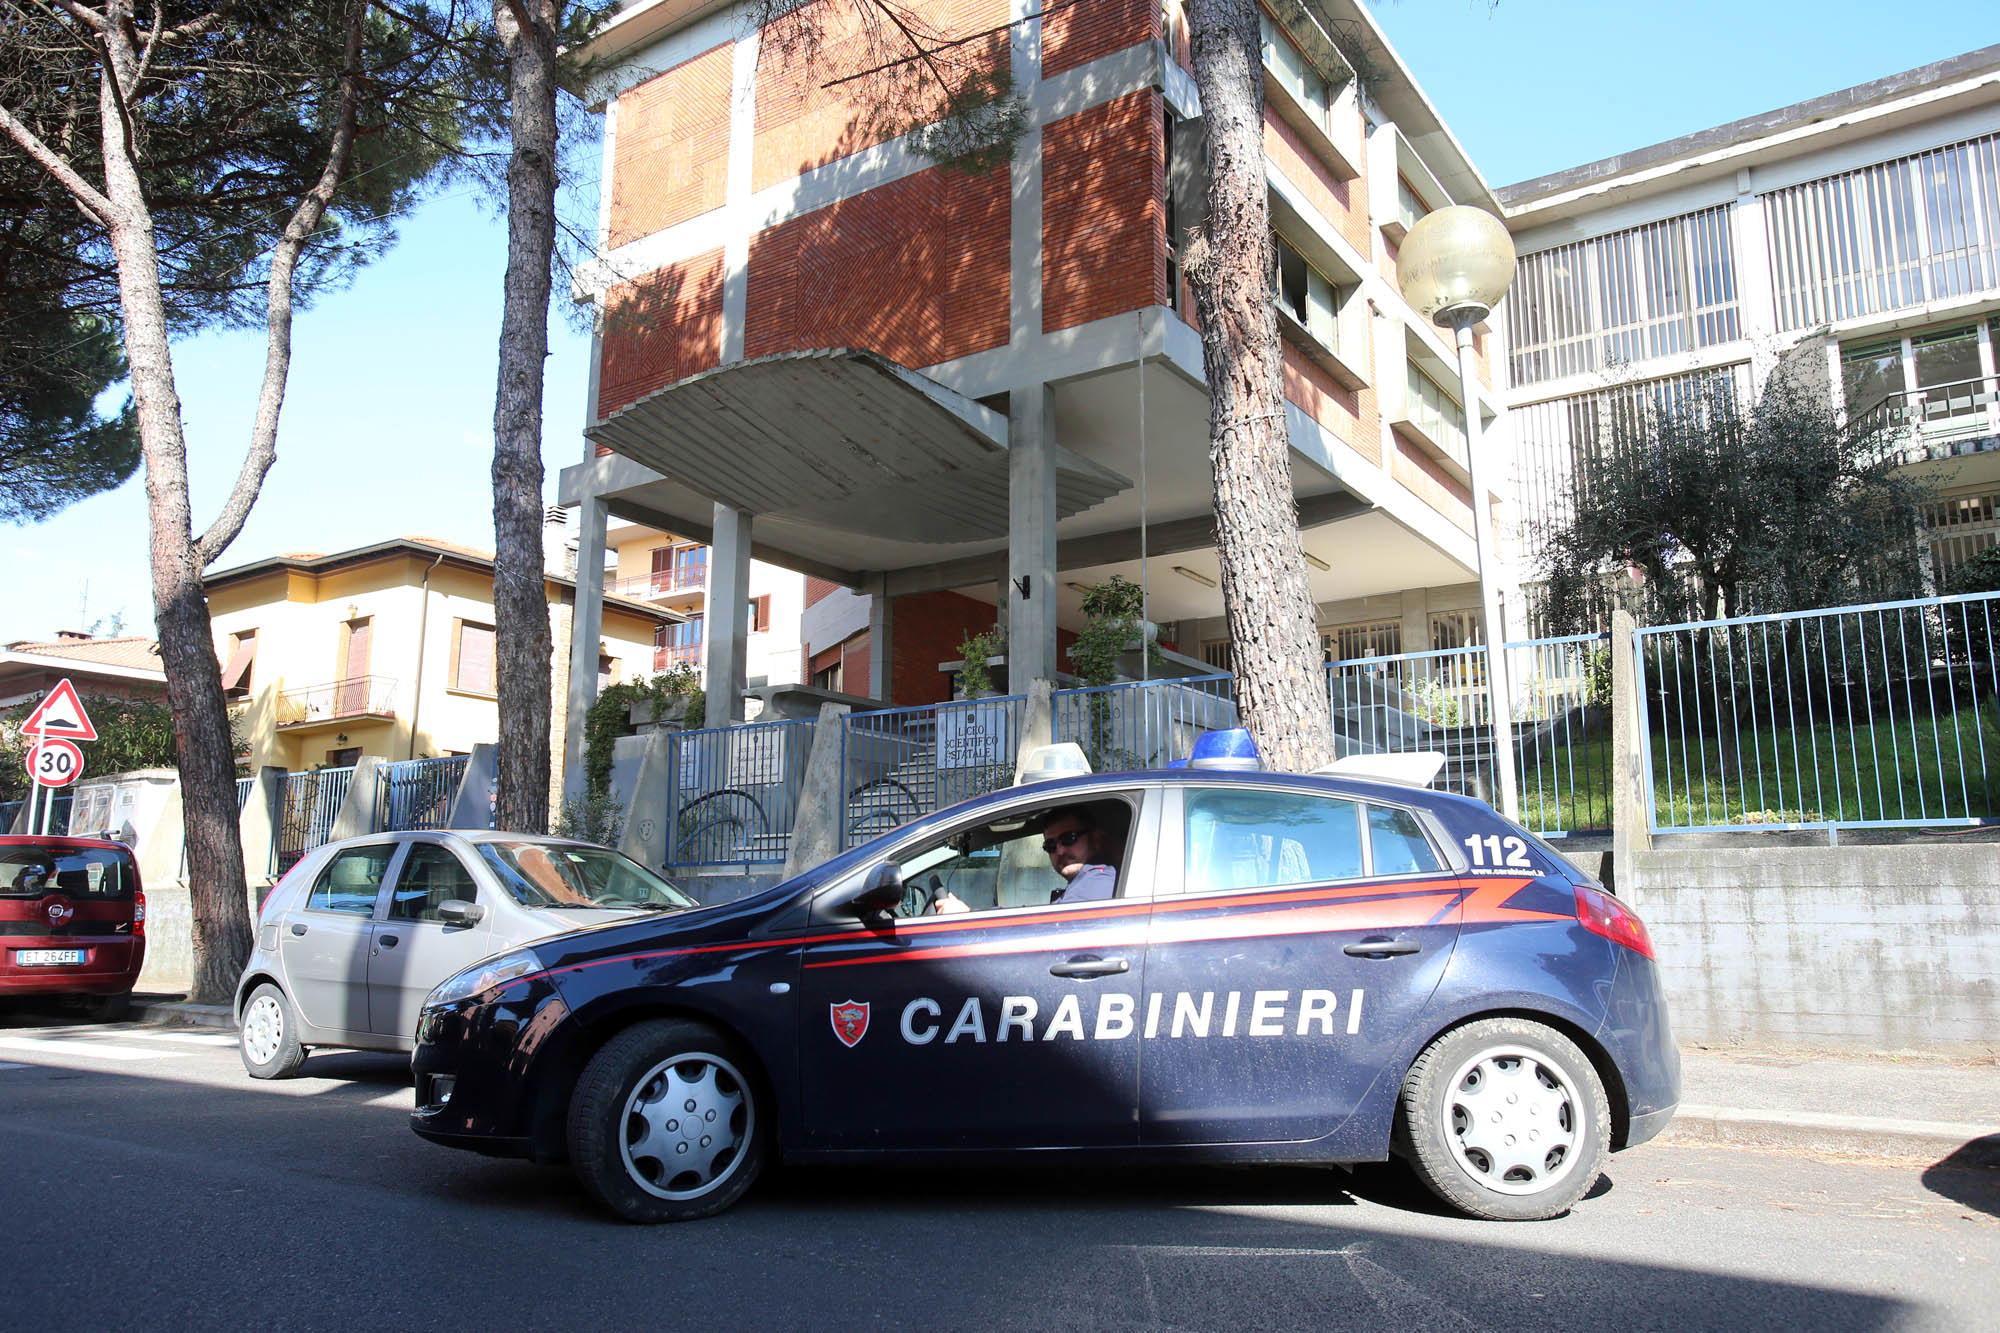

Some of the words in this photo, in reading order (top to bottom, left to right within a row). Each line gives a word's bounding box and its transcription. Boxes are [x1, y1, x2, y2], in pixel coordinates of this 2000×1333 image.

[958, 725, 985, 737] LCEO
[944, 735, 999, 749] SCENTFCO
[40, 752, 71, 773] 30
[1464, 834, 1532, 867] 112
[25, 951, 39, 962] ET
[44, 951, 77, 962] 264FF
[900, 988, 1364, 1044] CARABINIERI
